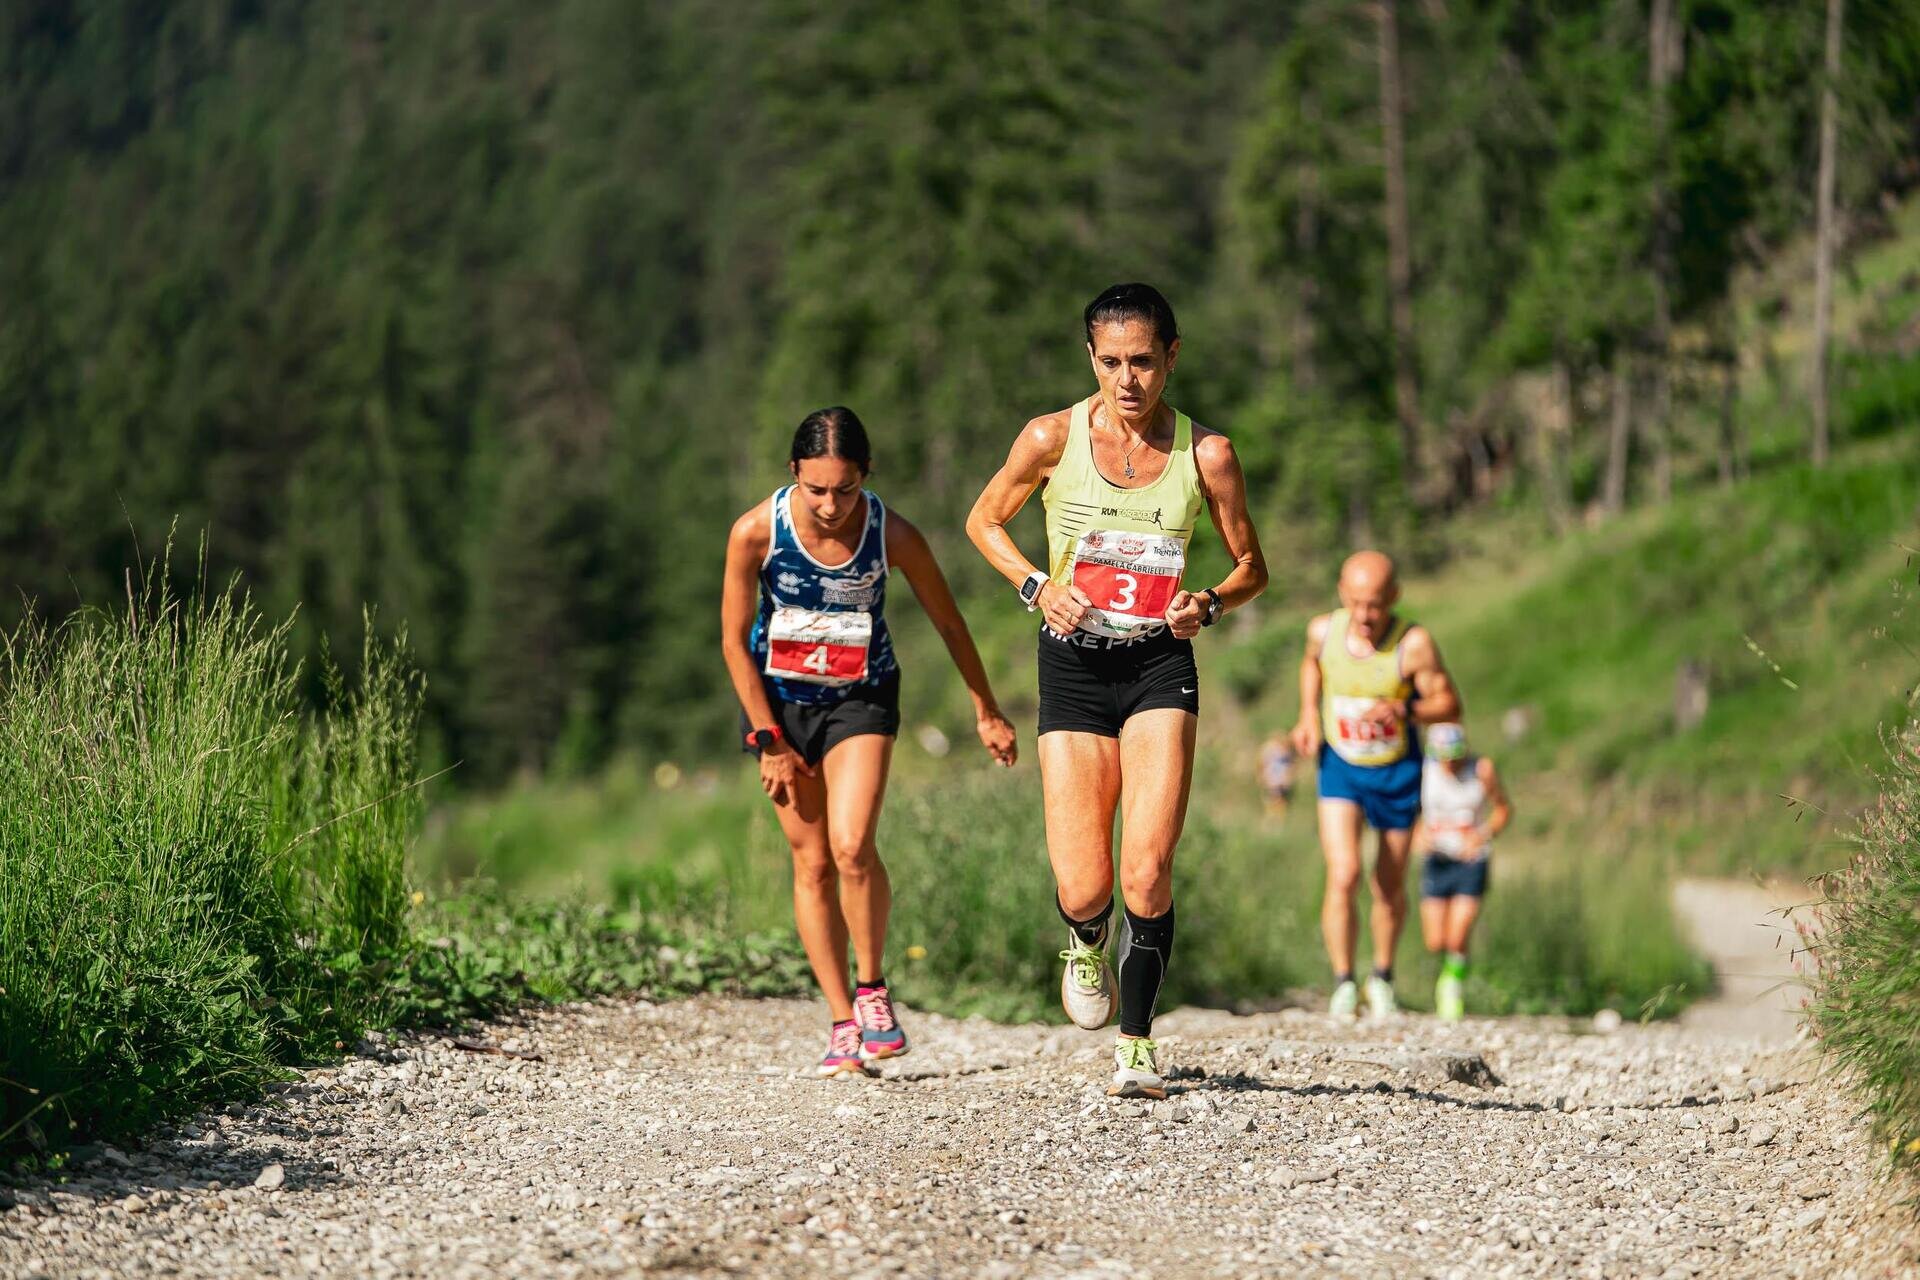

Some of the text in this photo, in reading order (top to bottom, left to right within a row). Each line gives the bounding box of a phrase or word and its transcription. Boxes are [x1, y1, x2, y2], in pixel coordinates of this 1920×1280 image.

[1101, 507, 1118, 517] RUN
[1093, 557, 1165, 575] PAMELA GABRIELLI
[1109, 573, 1138, 611] 3
[802, 645, 832, 674] 4
